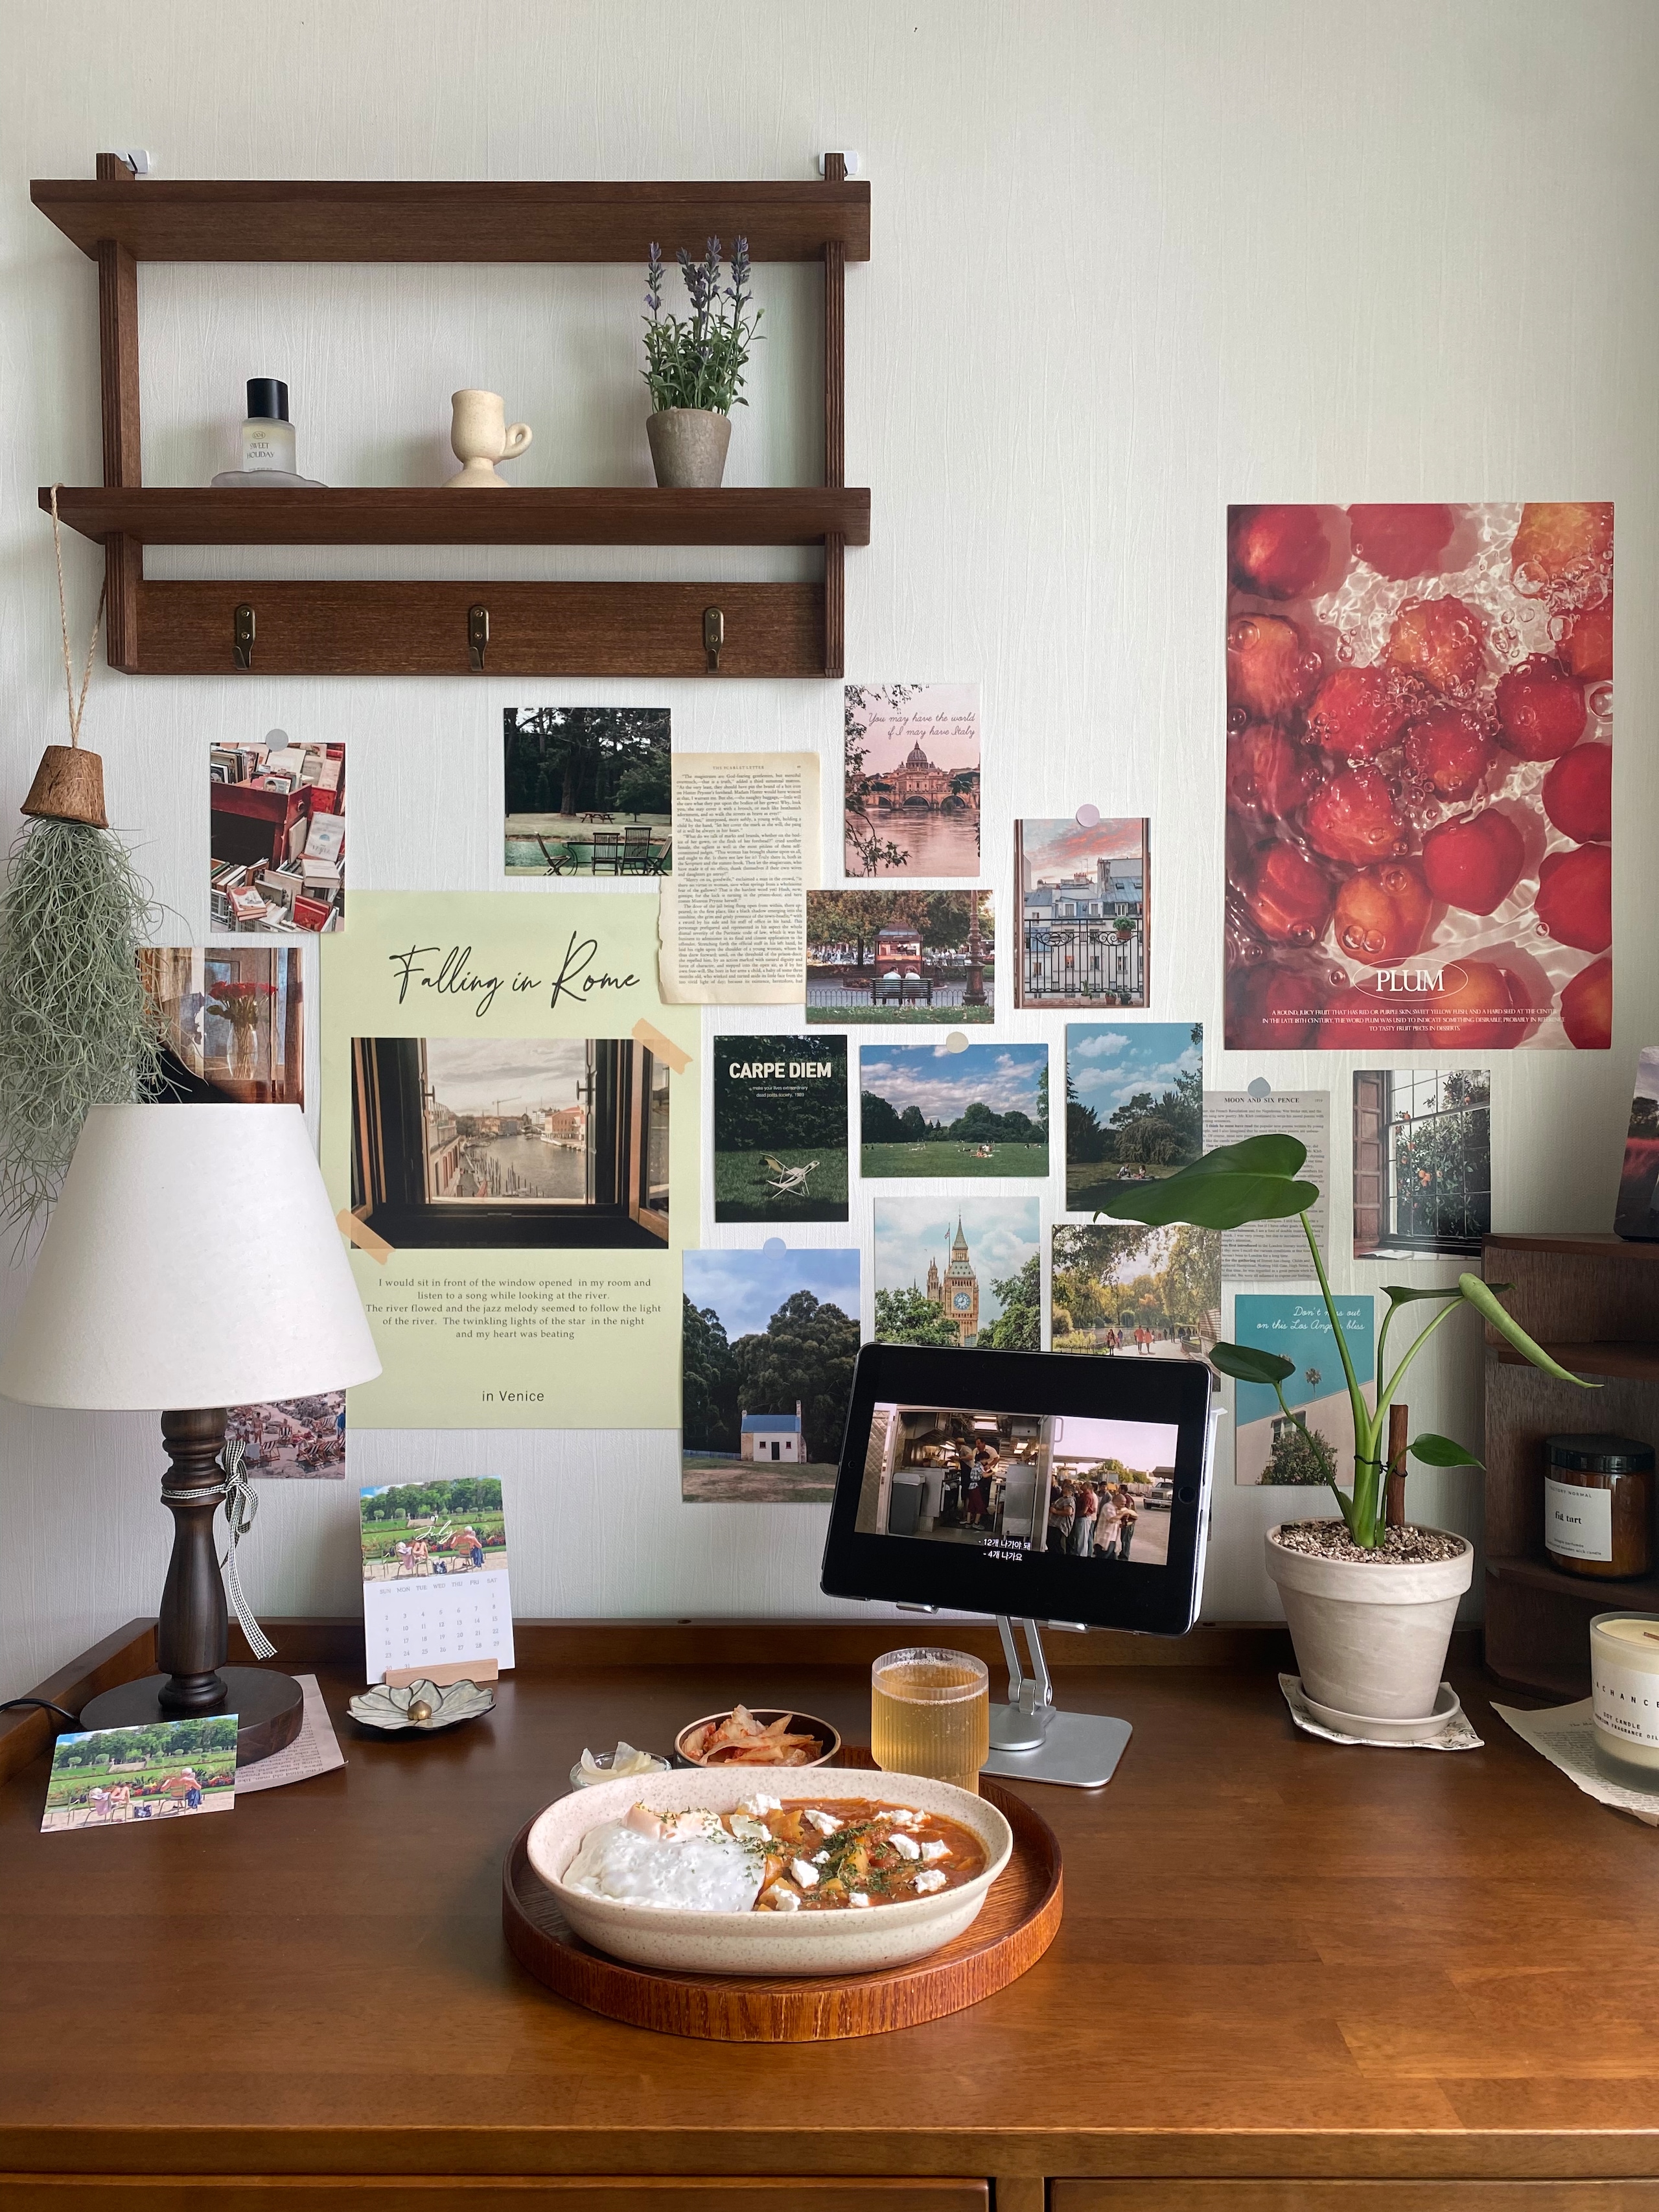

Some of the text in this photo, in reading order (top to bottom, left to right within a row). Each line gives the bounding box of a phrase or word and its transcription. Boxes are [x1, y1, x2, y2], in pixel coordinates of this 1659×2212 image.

[869, 712, 975, 727] You may have the world
[888, 726, 975, 739] if I may have Italy
[389, 930, 641, 1017] Falling in Rome
[1375, 970, 1445, 992] PLUM
[729, 1062, 831, 1078] CARPE DIEM
[385, 1278, 414, 1286] would
[444, 1278, 466, 1286] front
[469, 1278, 478, 1286] of
[481, 1278, 496, 1286] the
[539, 1279, 572, 1288] opened
[418, 1291, 443, 1299] listen
[519, 1291, 553, 1301] looking
[483, 1305, 501, 1314] jazz
[505, 1304, 538, 1314] melody
[640, 1304, 661, 1314] light
[1294, 1306, 1321, 1316] Don't
[463, 1317, 507, 1327] twinkling
[511, 1317, 536, 1327] lights
[620, 1317, 644, 1327] night
[1272, 1320, 1288, 1329] this
[1290, 1320, 1308, 1329] Los
[1346, 1320, 1365, 1330] bliss
[456, 1329, 472, 1338] and
[476, 1332, 490, 1340] my
[540, 1329, 574, 1340] beating
[482, 1390, 544, 1401] in Venice
[1555, 1511, 1582, 1524] fig tart
[414, 1520, 458, 1544] July
[983, 1538, 1031, 1551] 12개 나가야 돼
[988, 1550, 1023, 1561] 4개 나가요
[1603, 1712, 1641, 1730] SOY CANDLE
[1611, 1723, 1642, 1737] FRAGRANCE
